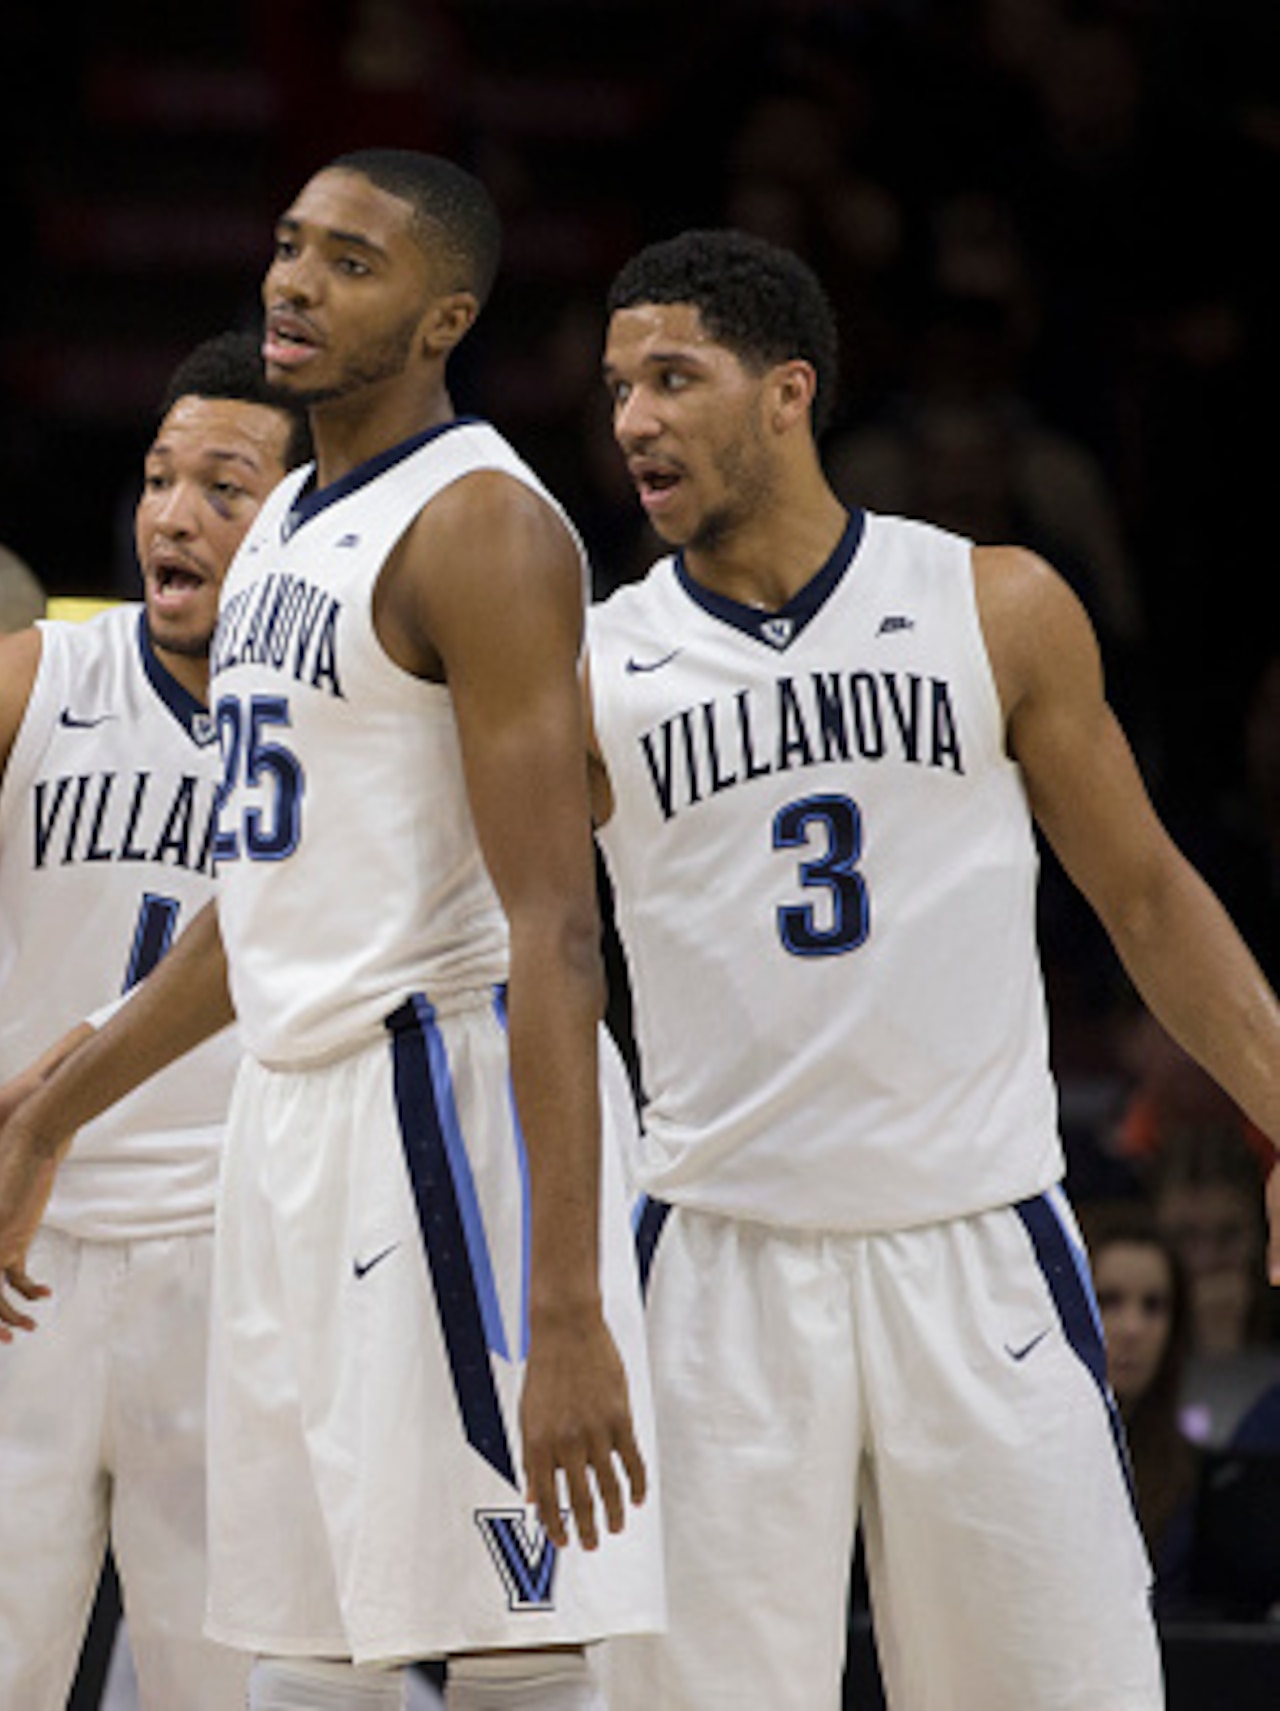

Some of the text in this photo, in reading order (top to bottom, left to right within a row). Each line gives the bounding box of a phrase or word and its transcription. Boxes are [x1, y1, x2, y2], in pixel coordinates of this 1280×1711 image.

[212, 692, 305, 862] 25
[638, 670, 965, 823] VILLANOVA
[771, 792, 871, 958] 3
[474, 1508, 570, 1612] V
